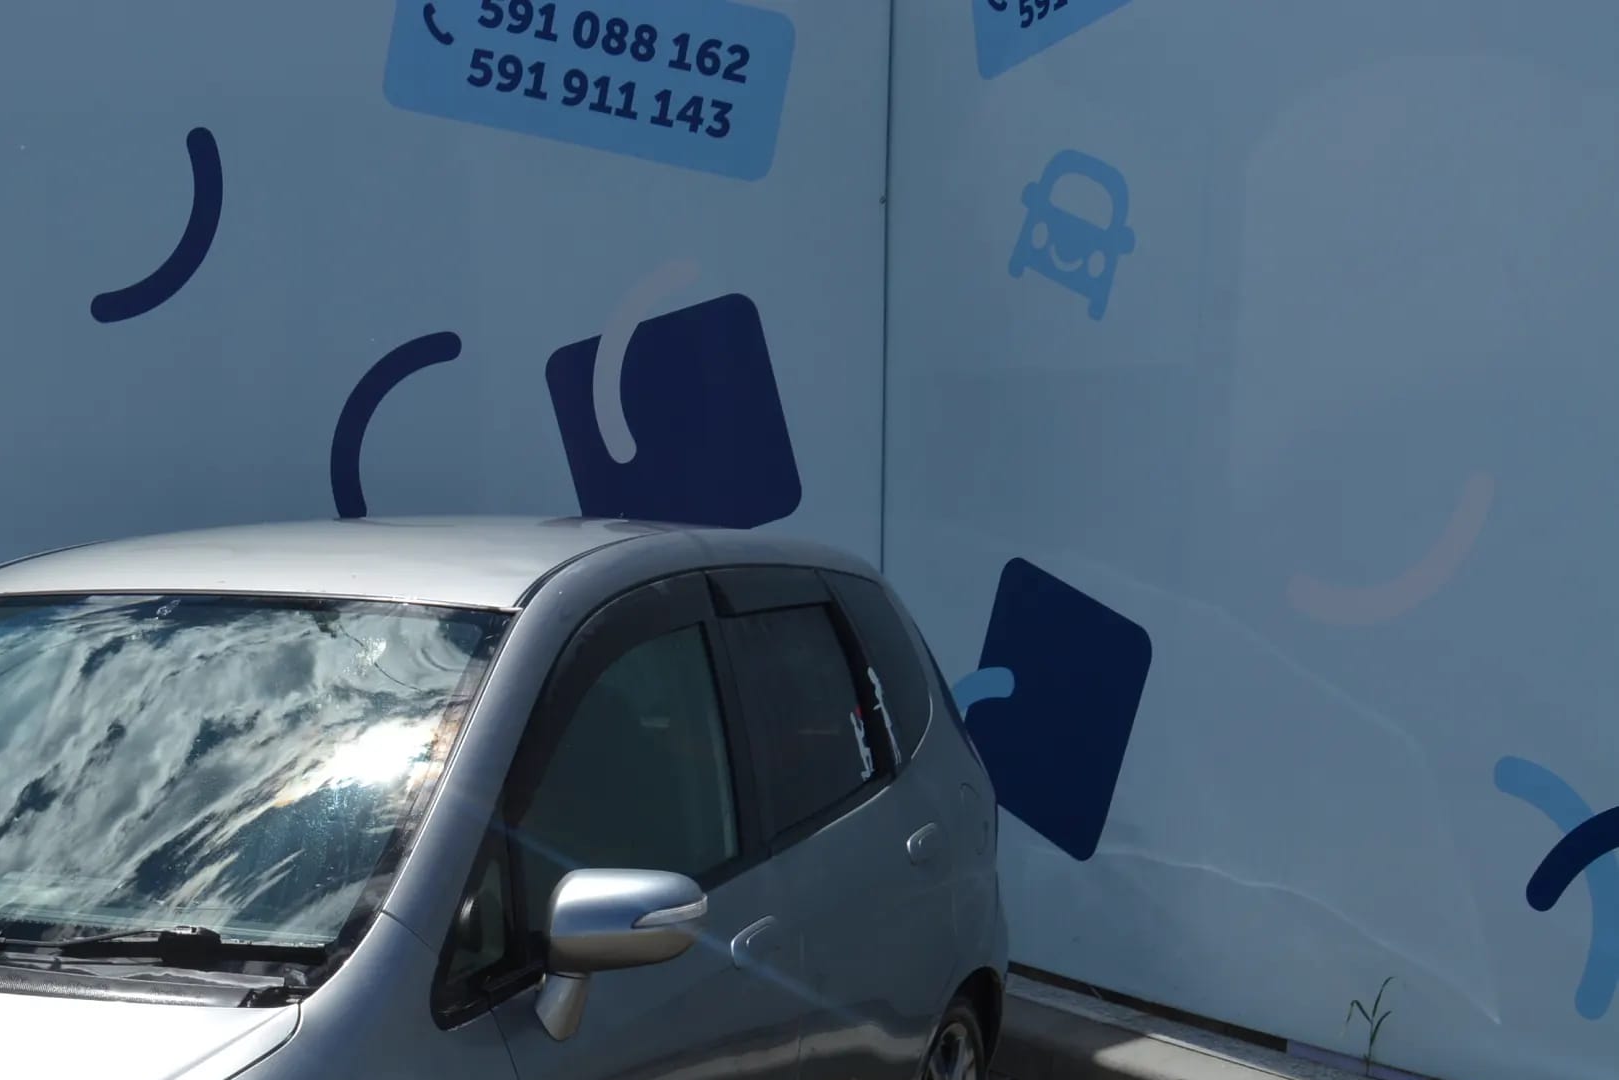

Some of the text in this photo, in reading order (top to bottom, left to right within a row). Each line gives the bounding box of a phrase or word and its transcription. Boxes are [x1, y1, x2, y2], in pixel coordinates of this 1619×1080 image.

[478, 0, 751, 84] 591 088 162
[466, 48, 734, 139] 591 911 143
